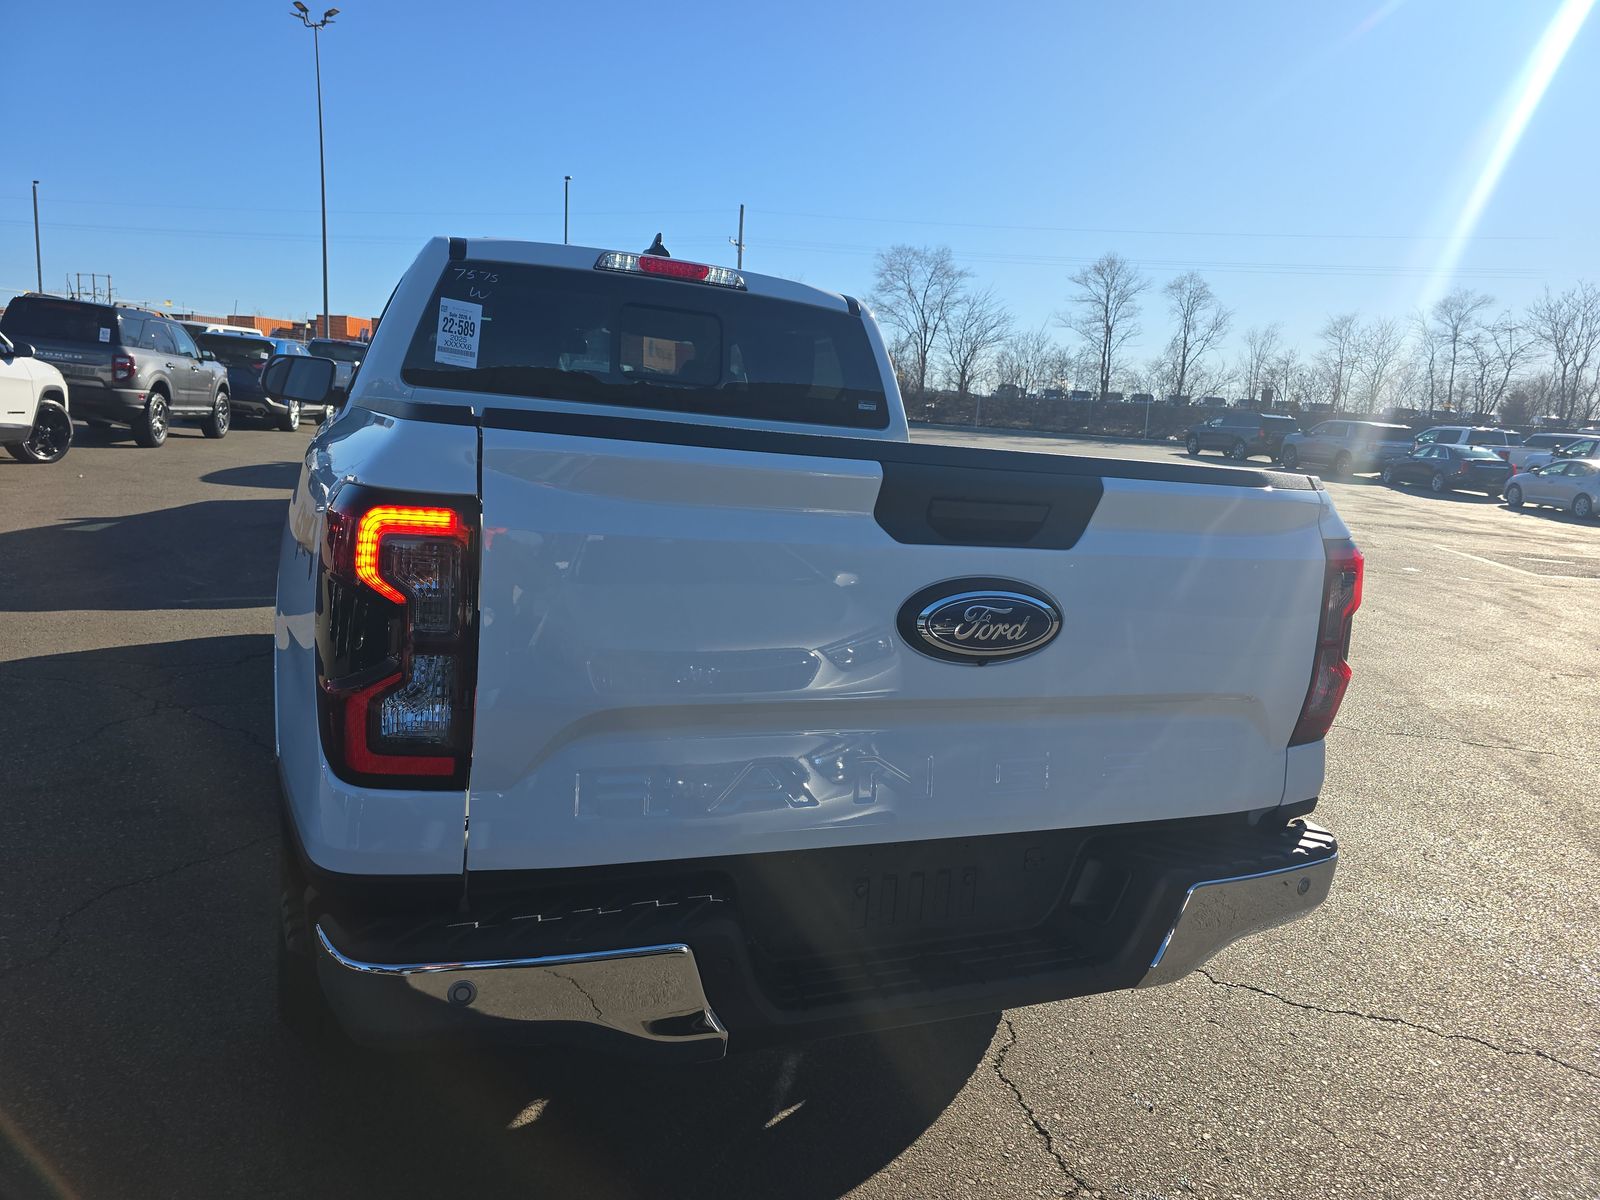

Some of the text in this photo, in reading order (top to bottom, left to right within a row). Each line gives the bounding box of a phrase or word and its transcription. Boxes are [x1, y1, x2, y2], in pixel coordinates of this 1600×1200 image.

[442, 316, 476, 338] 22:589
[450, 334, 468, 343] 2025
[954, 604, 1031, 641] Ford
[572, 742, 1252, 819] RANGE
